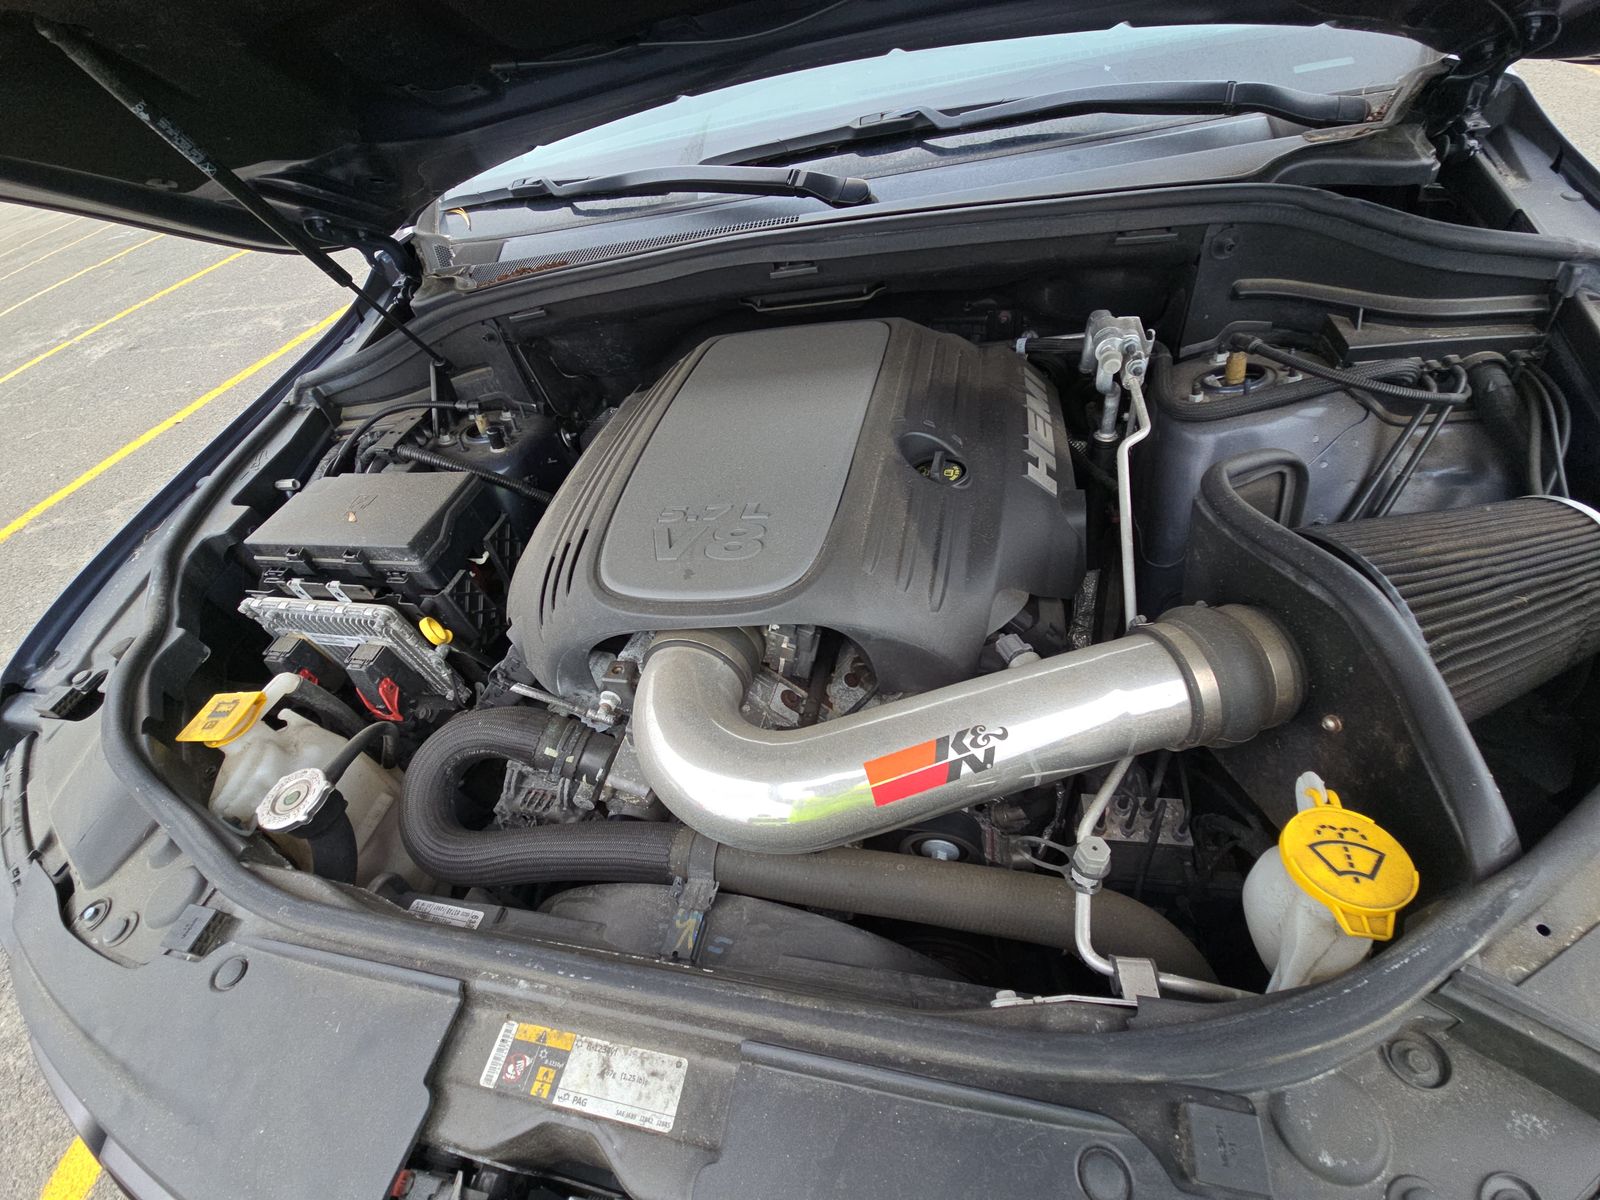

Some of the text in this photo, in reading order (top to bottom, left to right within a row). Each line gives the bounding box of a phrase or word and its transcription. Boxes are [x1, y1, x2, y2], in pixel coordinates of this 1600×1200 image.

[1024, 367, 1057, 495] HEMI
[657, 502, 770, 523] 5.7L
[653, 522, 768, 561] V8
[572, 1095, 587, 1107] PAG
